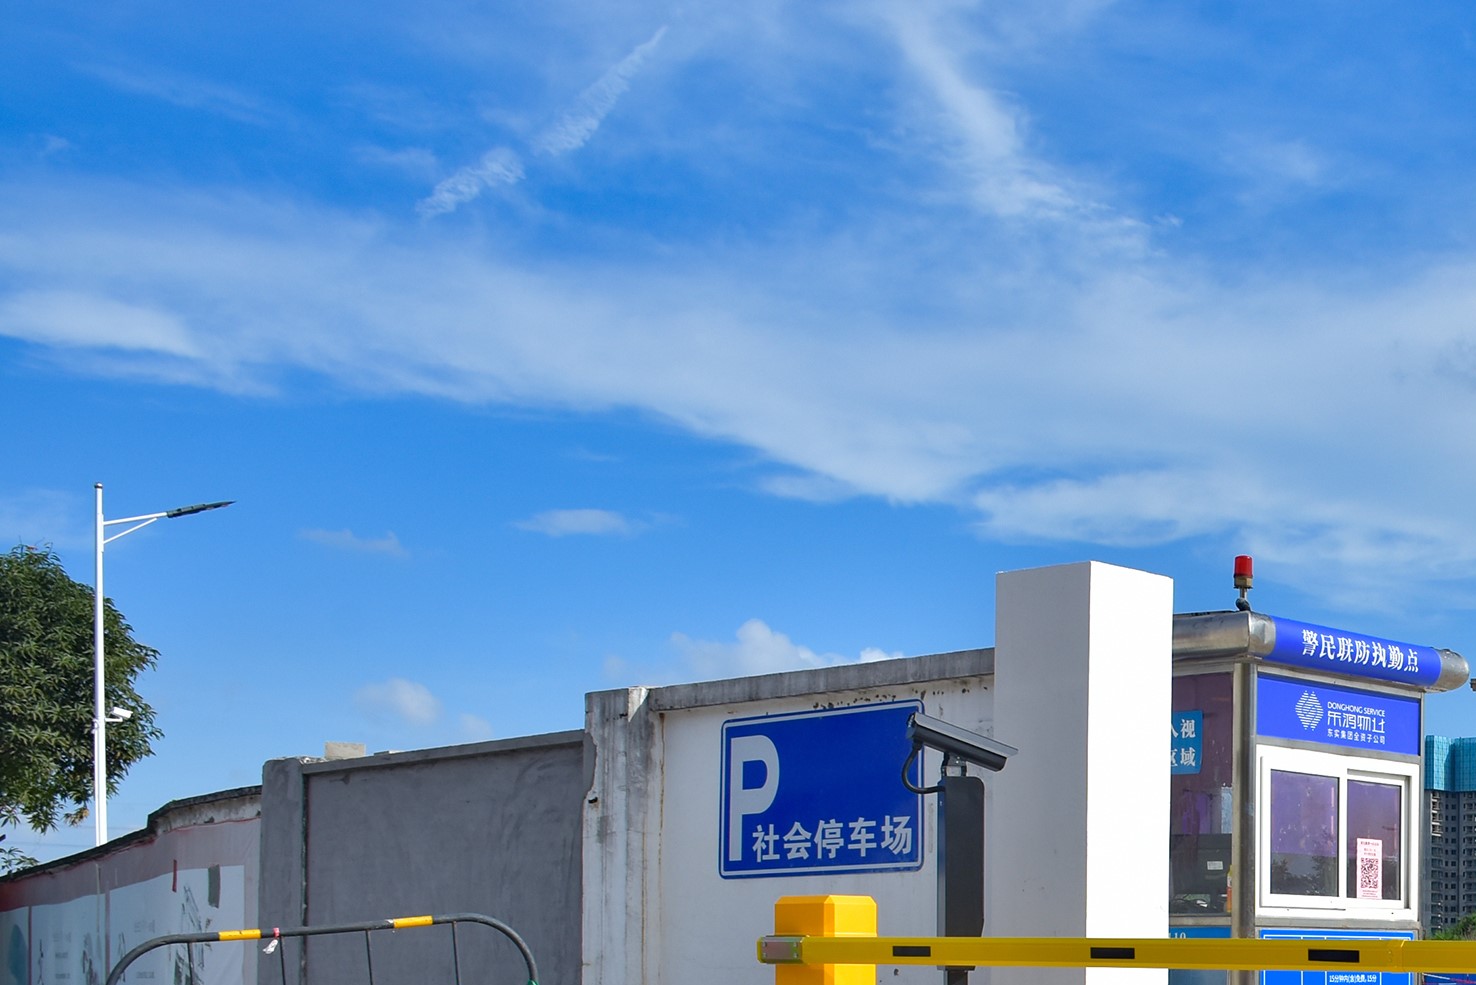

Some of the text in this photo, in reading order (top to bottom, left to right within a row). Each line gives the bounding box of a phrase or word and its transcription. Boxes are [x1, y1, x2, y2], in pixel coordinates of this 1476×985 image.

[1301, 629, 1419, 673] 警民联防执勤点
[1327, 701, 1386, 717] DONGHONG SERVICE
[1327, 728, 1386, 745] 东实集团全资子公司
[729, 734, 780, 863] P
[752, 815, 913, 863] 社会停车场
